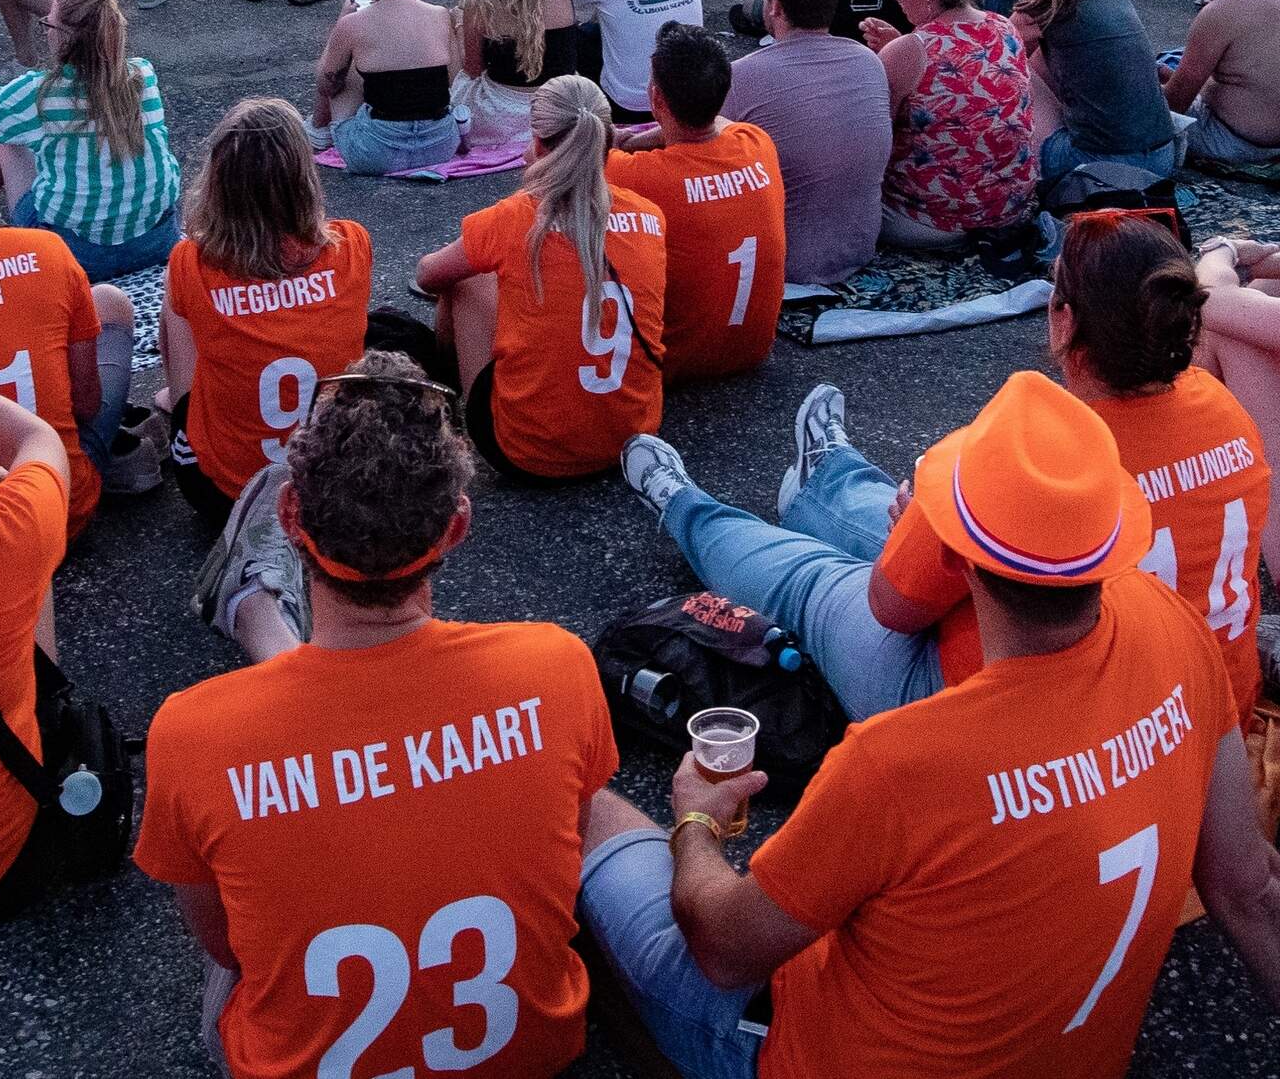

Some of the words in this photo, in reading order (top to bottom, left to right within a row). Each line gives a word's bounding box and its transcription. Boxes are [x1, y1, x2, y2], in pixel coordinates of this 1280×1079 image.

[605, 212, 639, 233] OBT
[684, 162, 770, 204] MEMPILS
[210, 269, 337, 317] WEGDORST
[727, 236, 758, 326] 1
[578, 281, 634, 394] 9
[258, 356, 319, 464] 9
[1137, 465, 1175, 503] ANI
[1138, 497, 1251, 641] 14
[227, 753, 320, 821] VAN
[332, 742, 396, 805] DE
[403, 696, 544, 789] KAART
[986, 748, 1107, 825] JUSTIN
[1101, 683, 1194, 789] ZUIPERT
[1061, 822, 1160, 1034] 7
[303, 894, 519, 1079] 23
